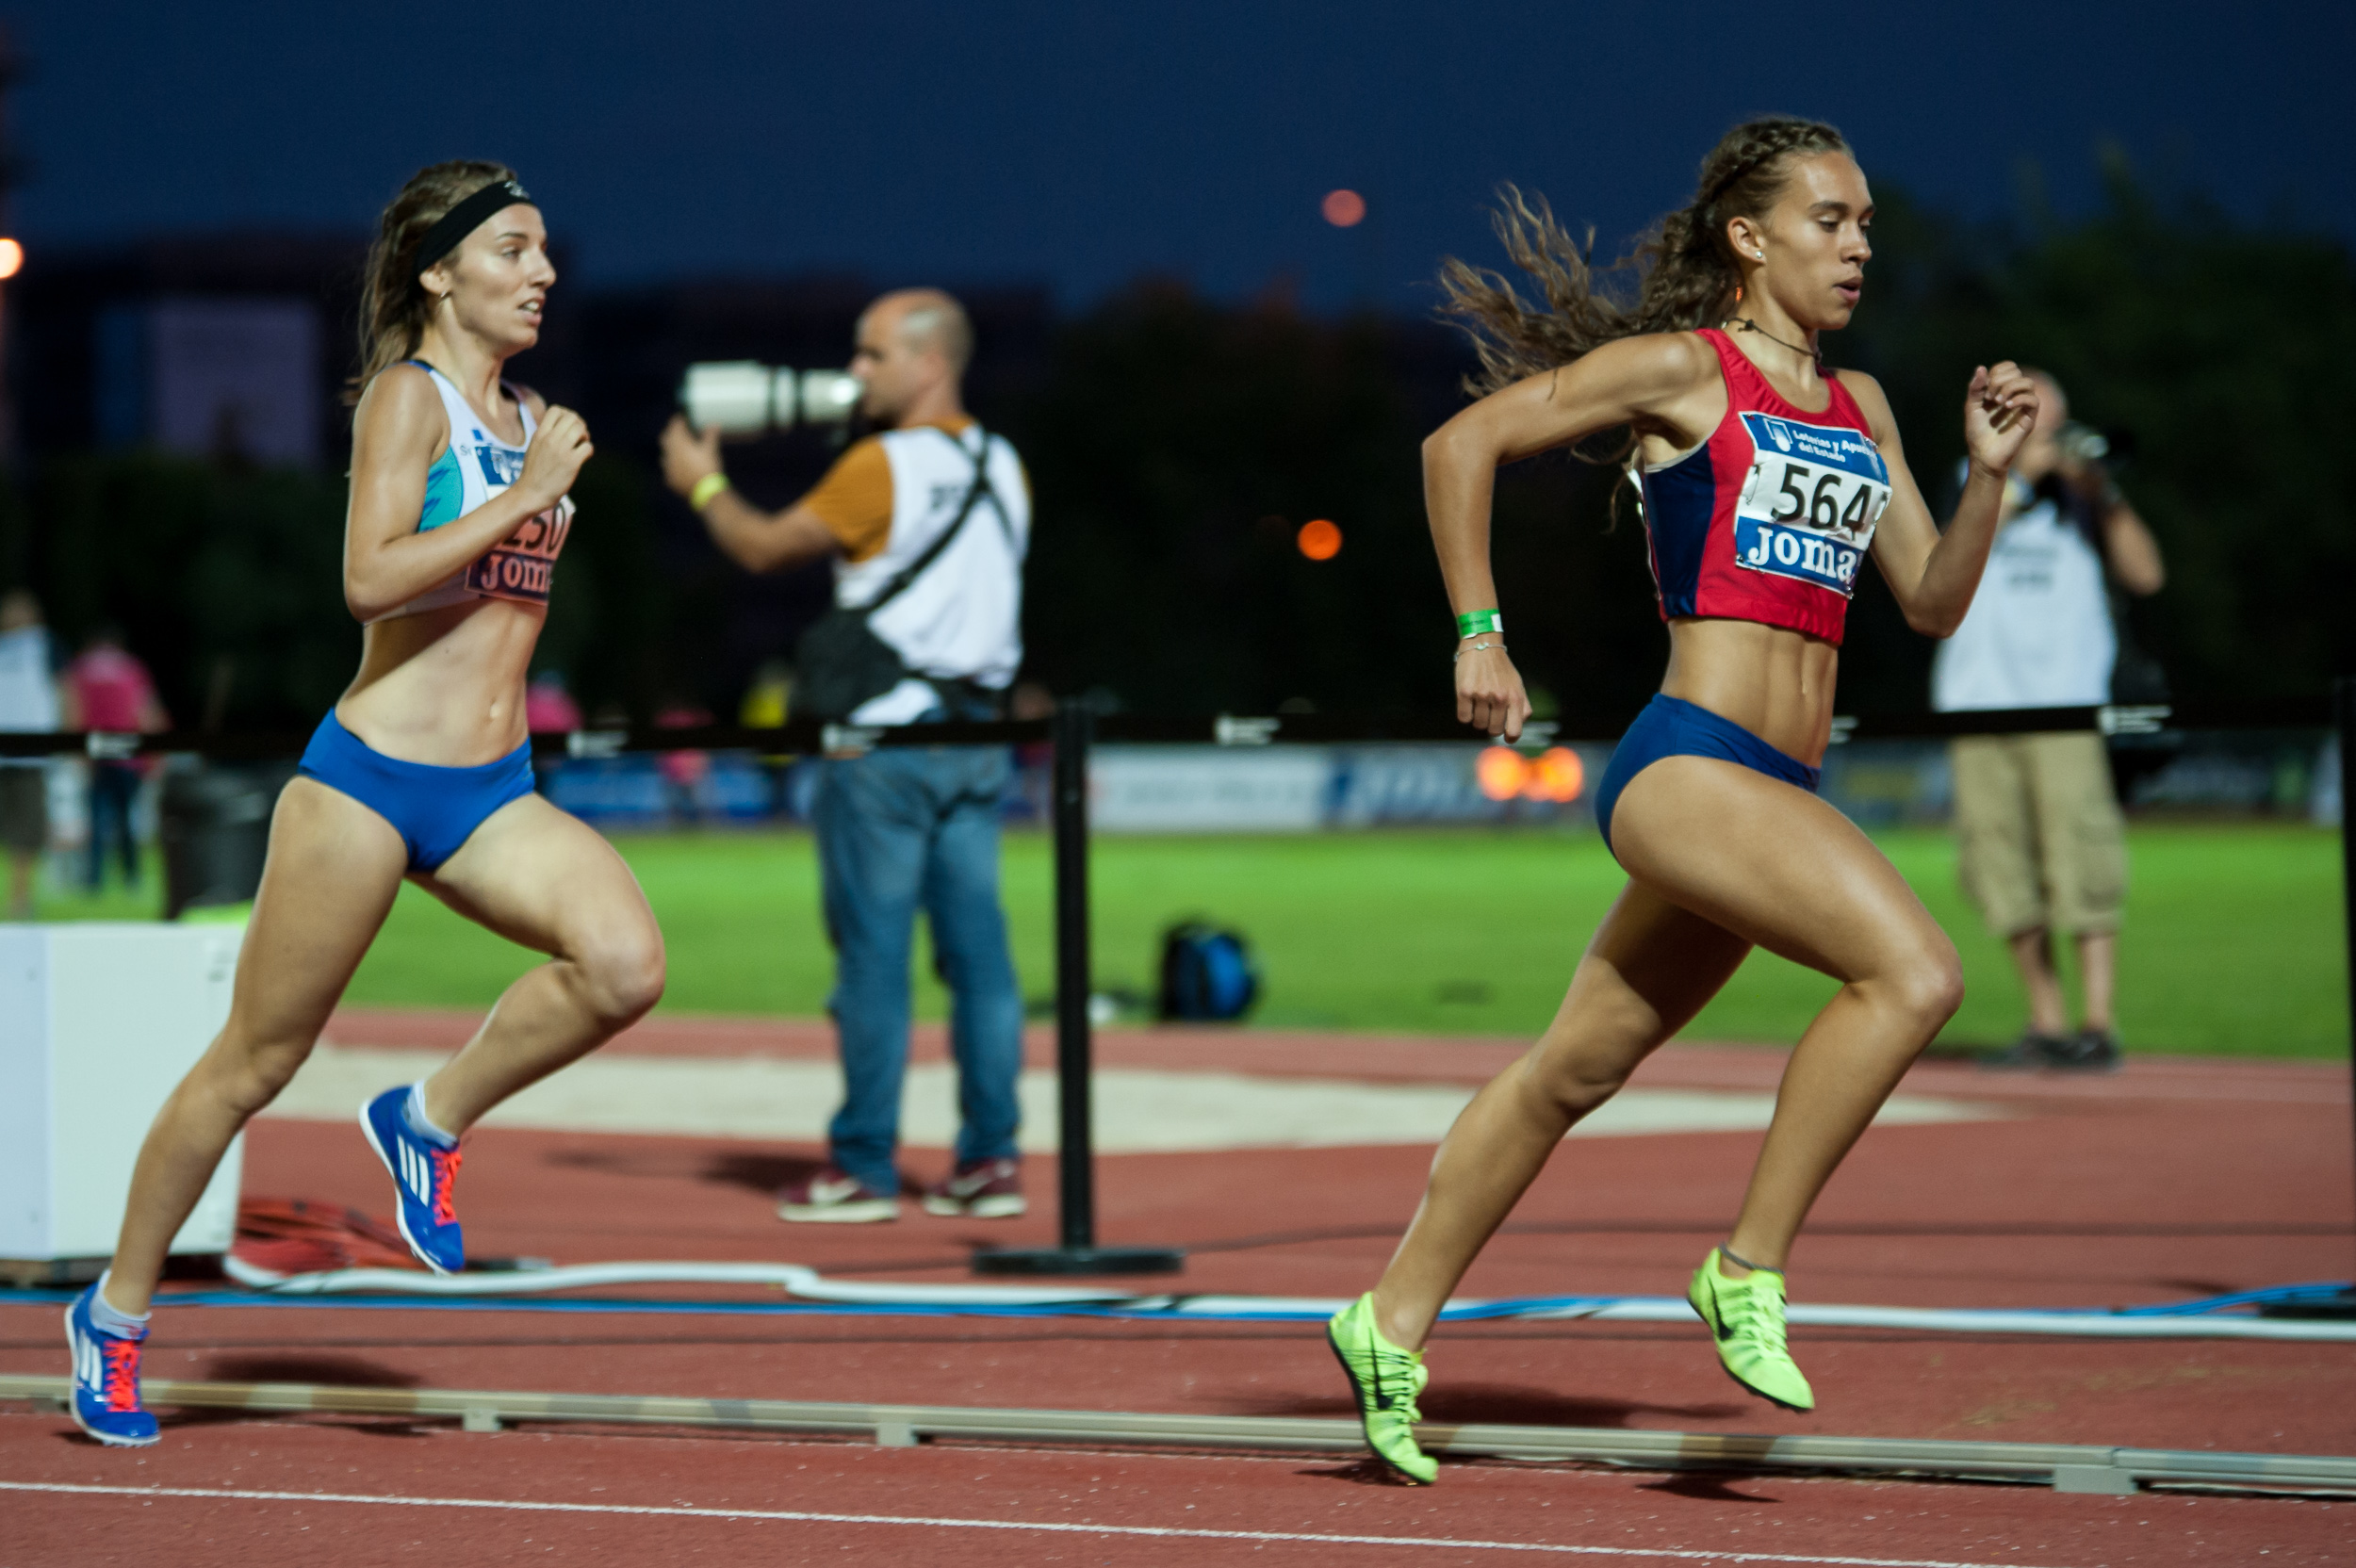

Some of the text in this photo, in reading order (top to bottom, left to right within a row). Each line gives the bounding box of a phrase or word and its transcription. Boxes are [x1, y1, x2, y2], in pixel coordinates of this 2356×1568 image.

[1798, 442, 1846, 463] del Estado
[1771, 463, 1873, 541] 564
[1748, 526, 1857, 583] Joma
